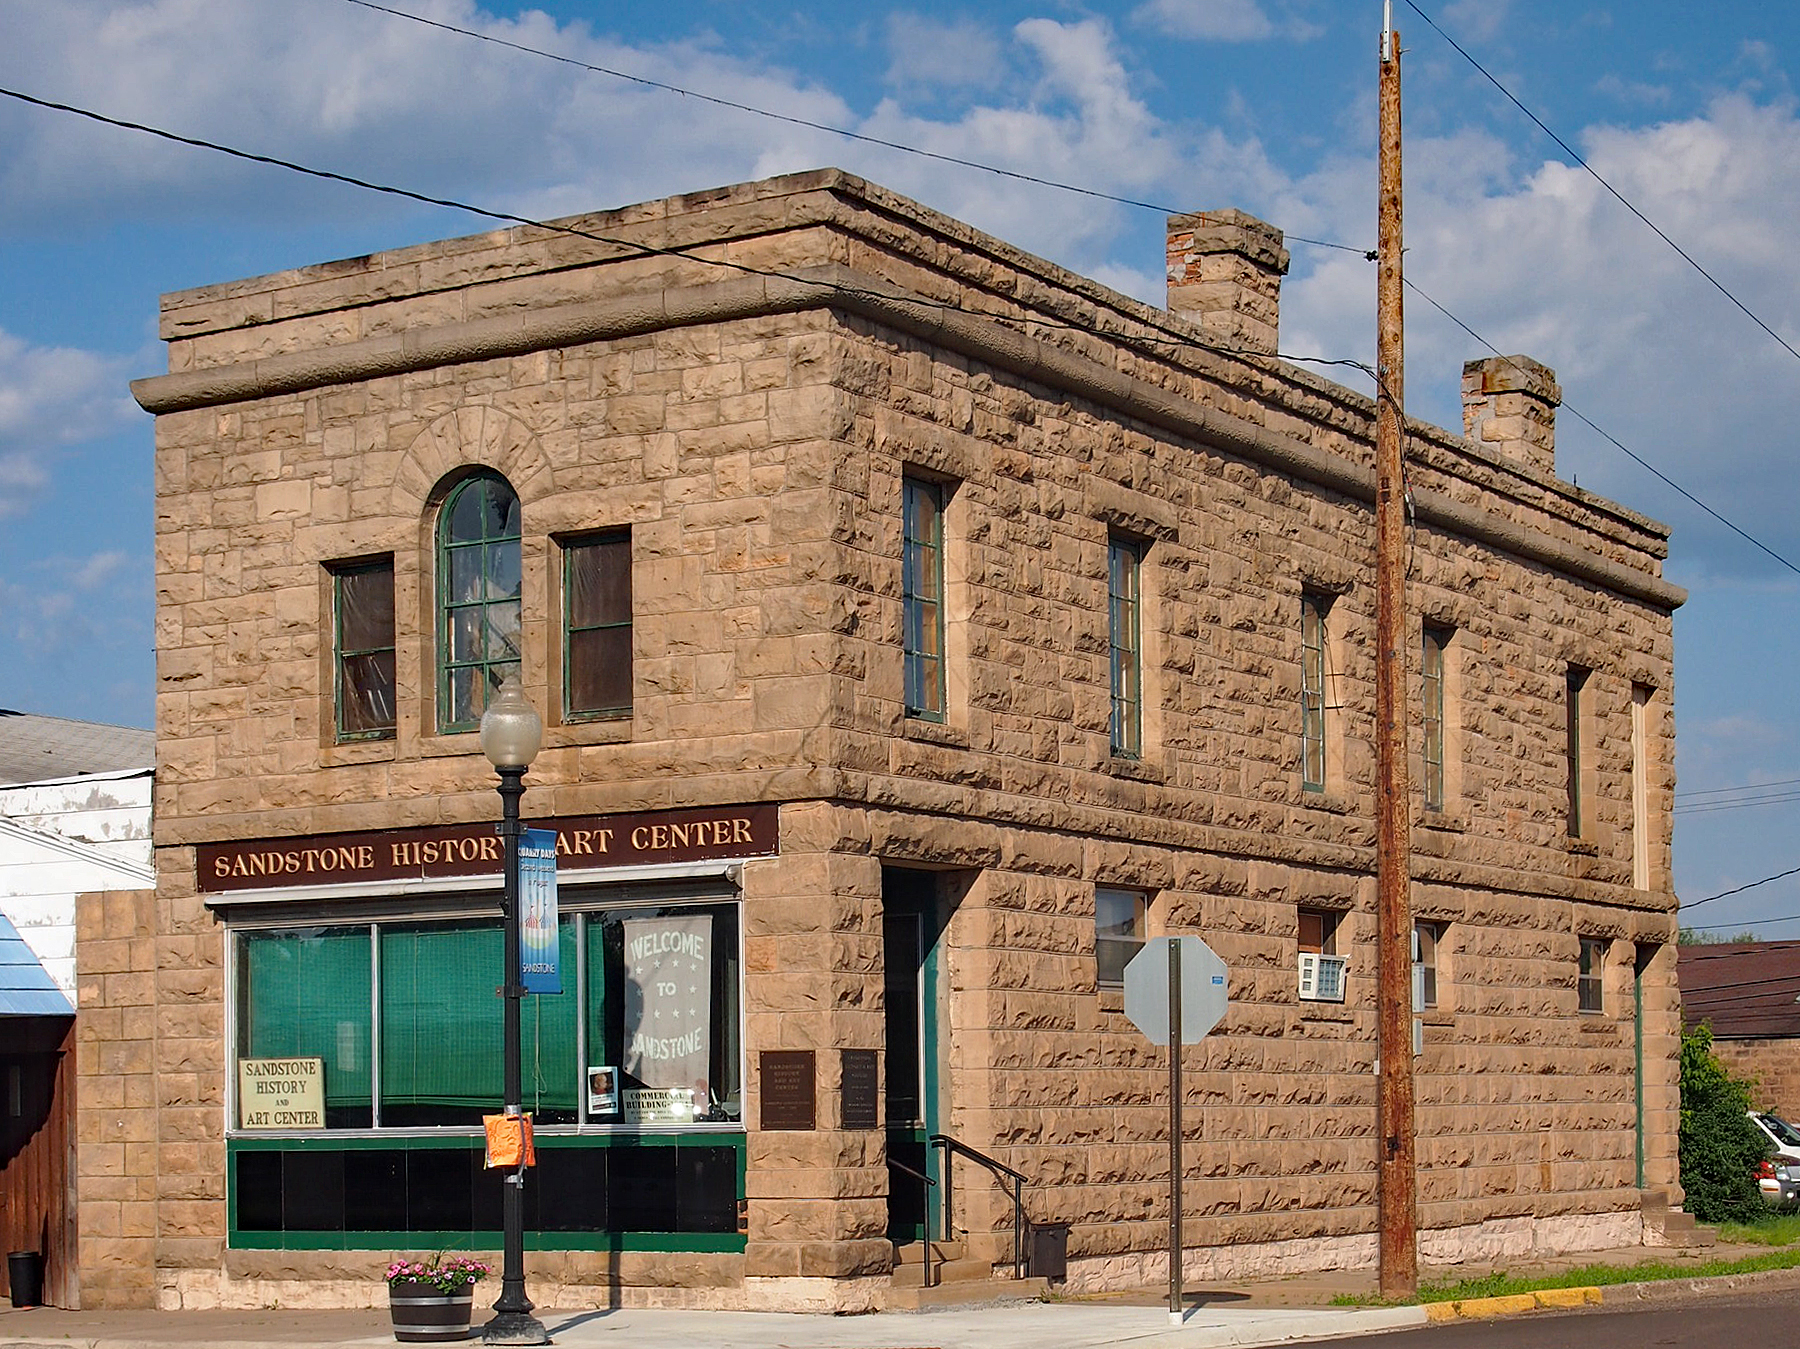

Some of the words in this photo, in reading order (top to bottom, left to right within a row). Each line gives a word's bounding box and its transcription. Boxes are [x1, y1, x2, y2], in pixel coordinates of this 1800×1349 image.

[214, 845, 375, 878] SANDSTONE
[555, 829, 614, 856] ART
[631, 818, 754, 851] CENTER
[630, 931, 704, 961] WELCOME
[657, 981, 677, 997] TO
[246, 1061, 316, 1076] SANDSTONE
[256, 1080, 307, 1094] HISTORY
[275, 1099, 290, 1107] AND
[247, 1111, 270, 1125] ART
[274, 1110, 319, 1125] CENTER
